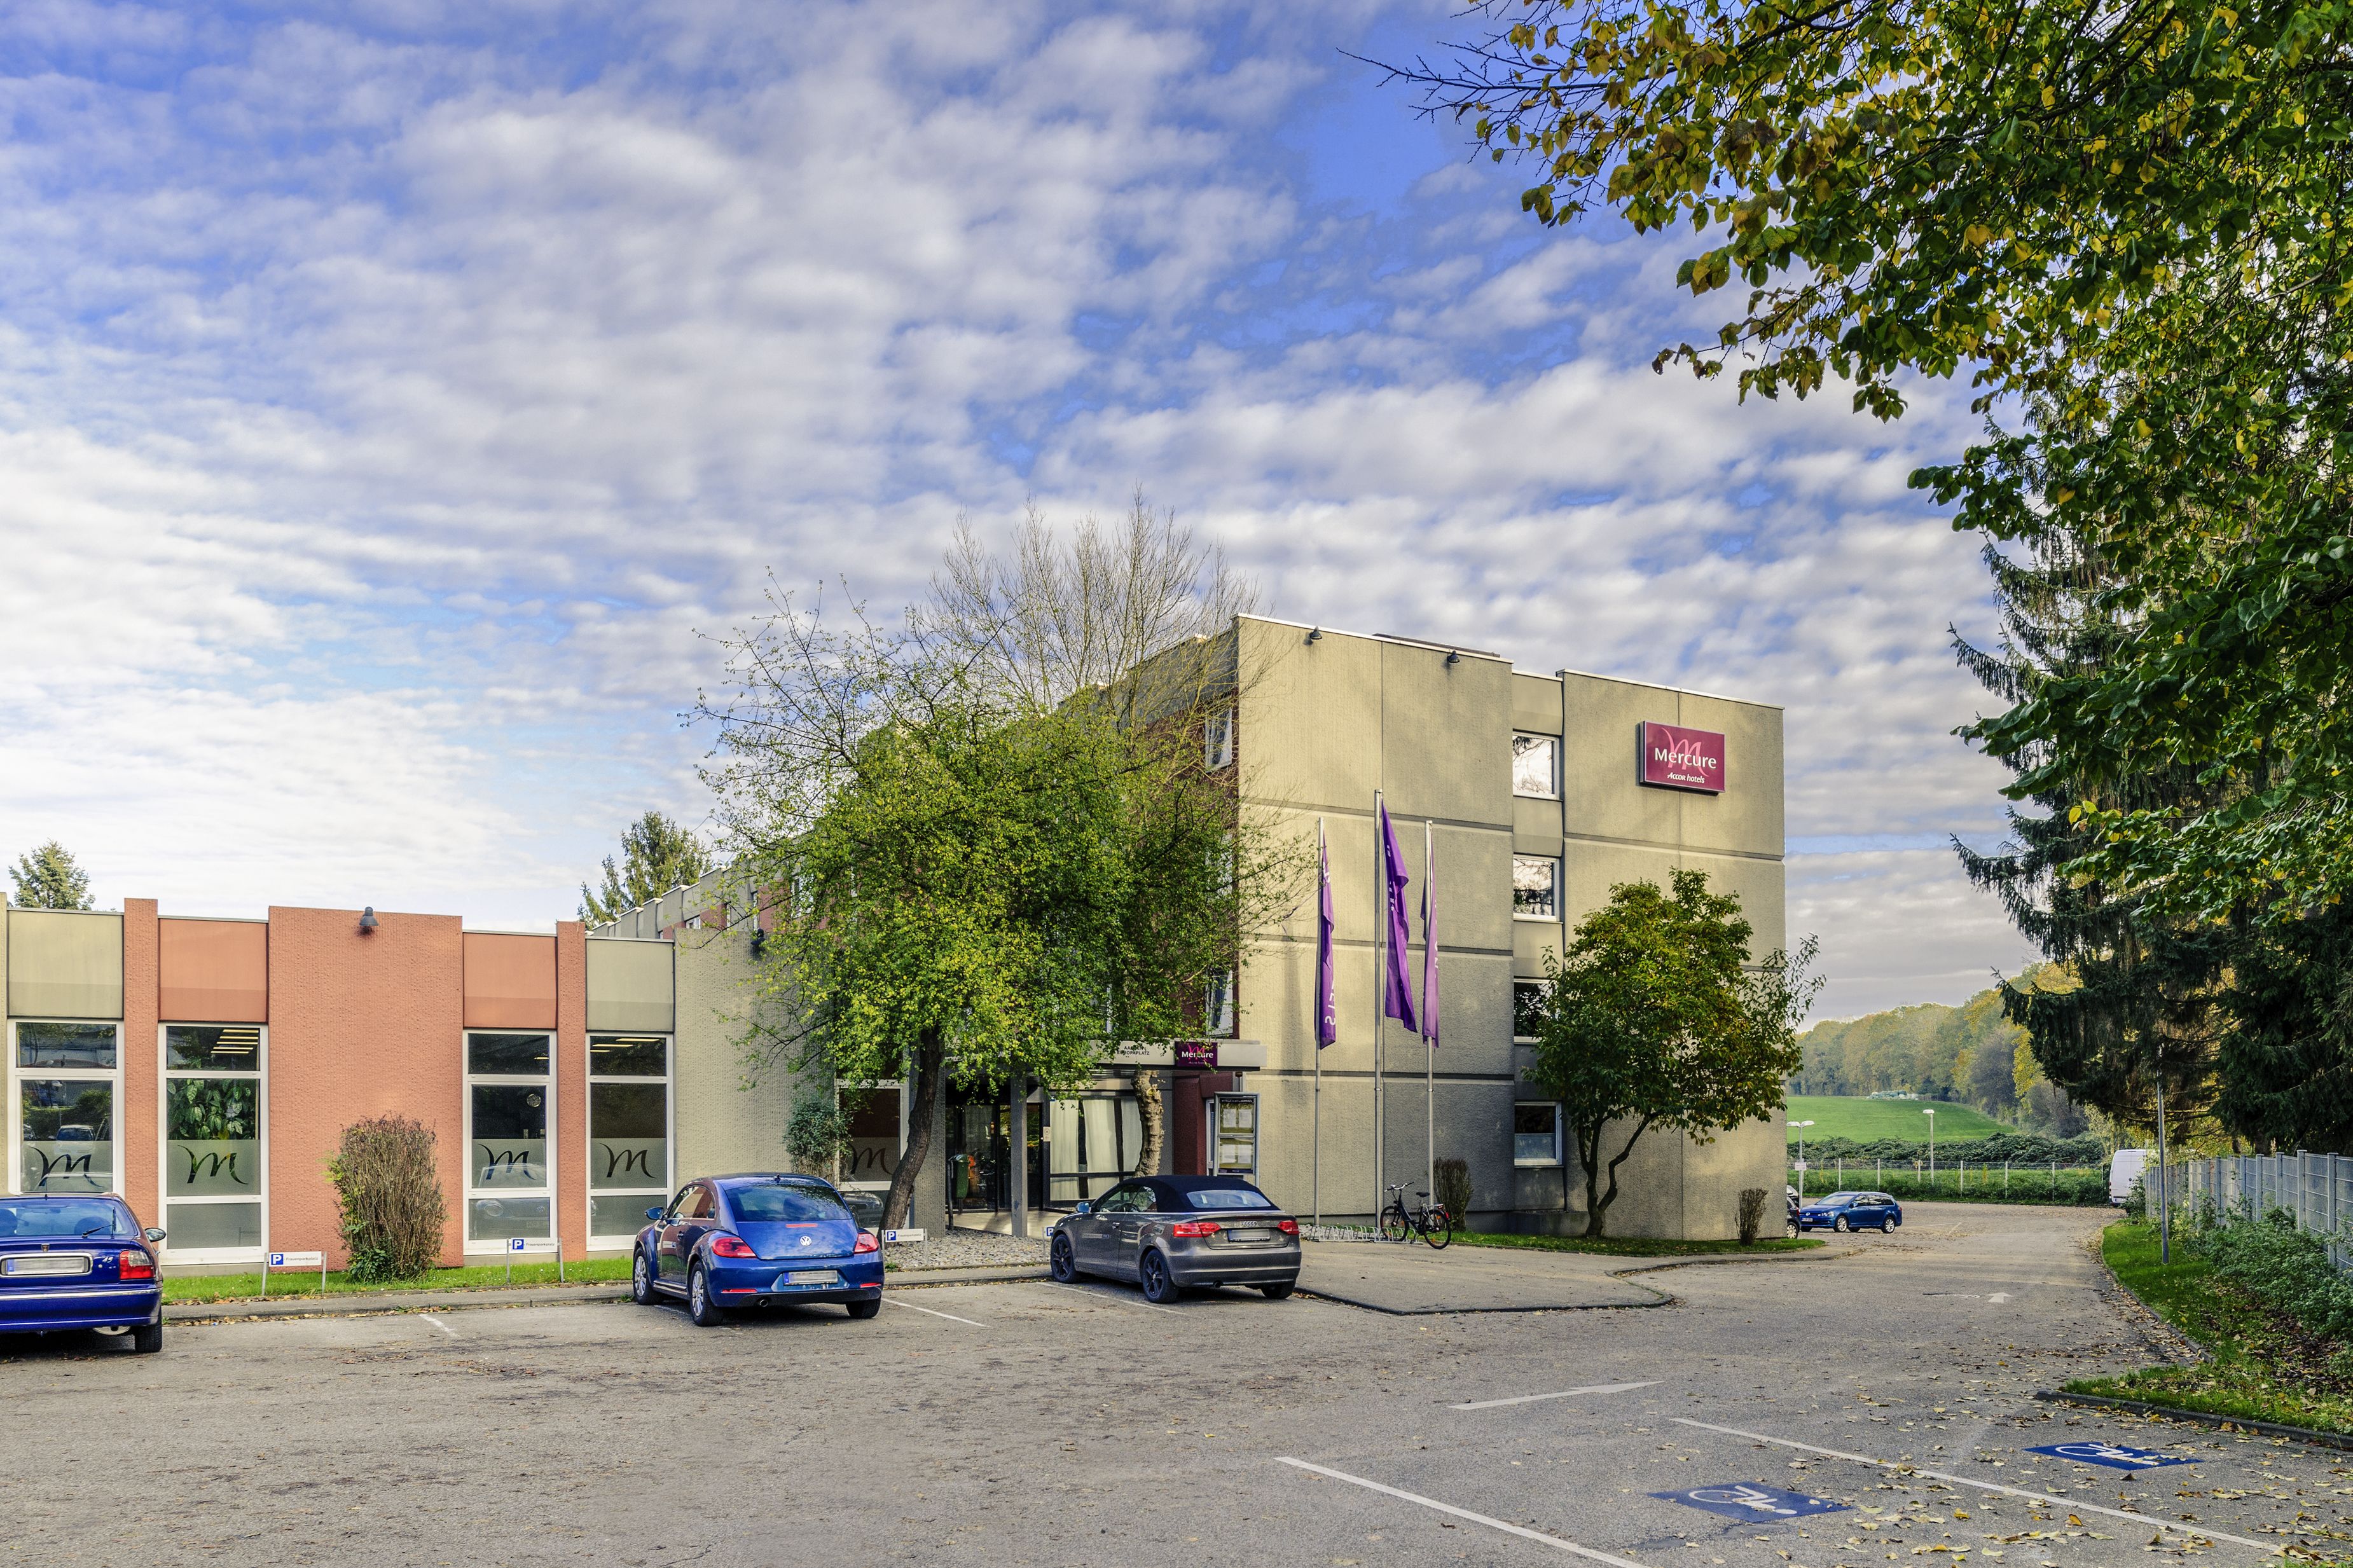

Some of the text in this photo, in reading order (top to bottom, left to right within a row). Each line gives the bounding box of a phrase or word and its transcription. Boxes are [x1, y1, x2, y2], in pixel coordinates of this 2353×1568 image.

[1655, 748, 1717, 769] Mercure
[1687, 774, 1705, 783] hotels
[888, 1232, 895, 1240] P
[514, 1240, 523, 1249] P
[272, 1255, 282, 1265] P
